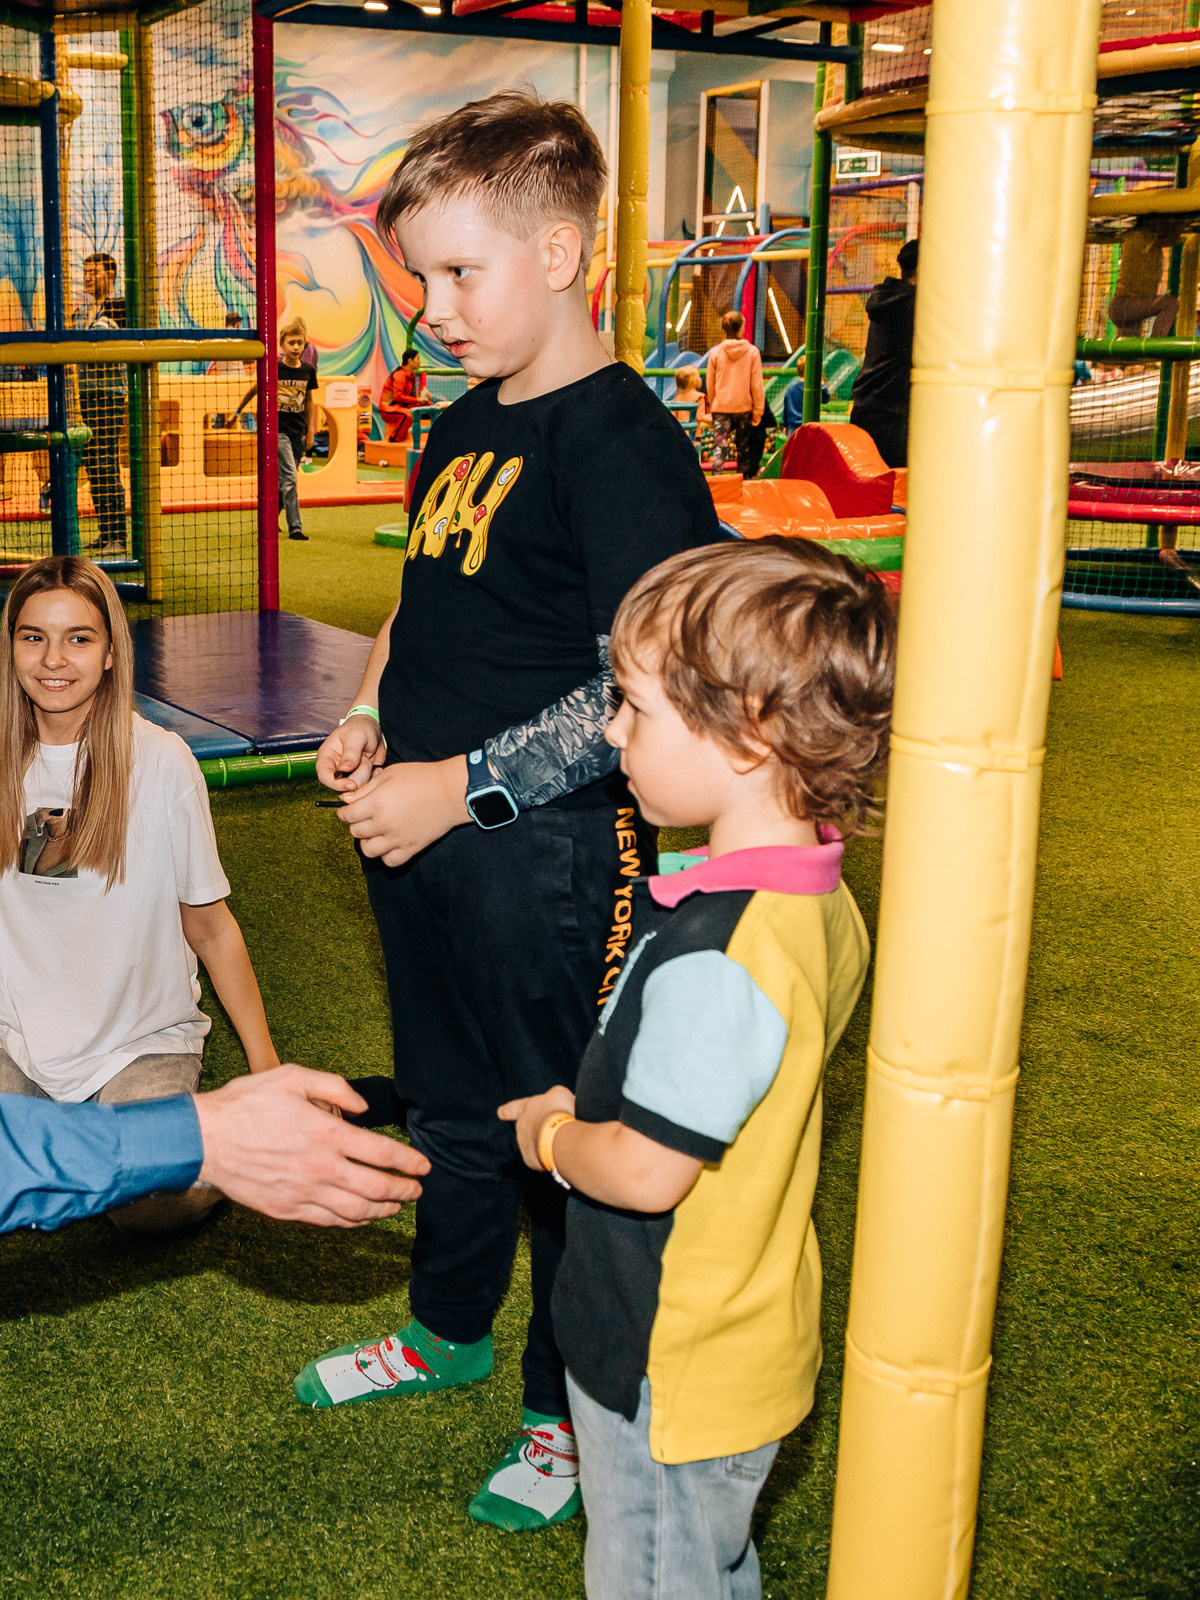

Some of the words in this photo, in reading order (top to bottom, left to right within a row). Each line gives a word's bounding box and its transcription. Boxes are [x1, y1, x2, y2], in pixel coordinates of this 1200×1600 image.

[614, 806, 642, 877] NEW
[604, 884, 633, 963] YORK
[597, 966, 622, 1021] CI
